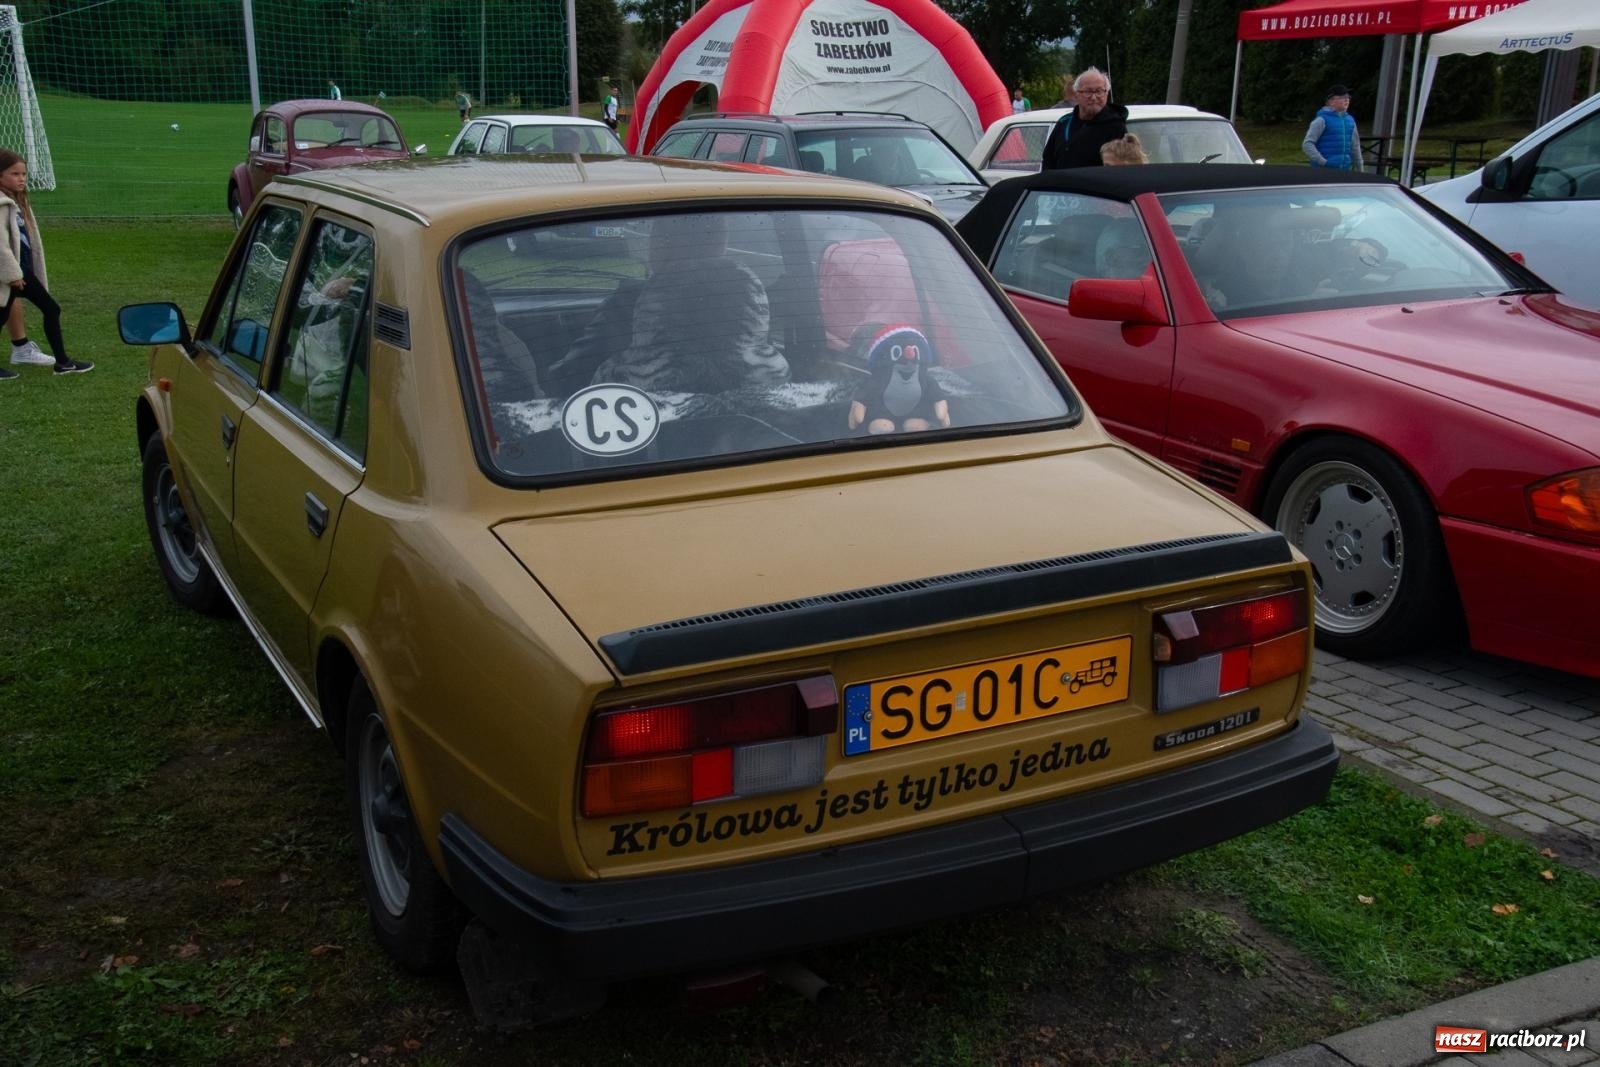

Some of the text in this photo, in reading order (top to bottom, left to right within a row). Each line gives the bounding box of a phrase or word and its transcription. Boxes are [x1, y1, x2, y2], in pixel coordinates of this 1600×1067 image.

[810, 19, 890, 38] SOŁECTWO
[1261, 11, 1391, 31] WWW.BOZIGORSKI.PL
[1500, 32, 1574, 49] ARTTECTUS
[814, 41, 892, 60] ZABEŁKÓW
[585, 396, 639, 445] CS
[881, 678, 953, 740] SG
[849, 728, 867, 744] PL
[606, 737, 1111, 856] Królowa jest tylko jedna
